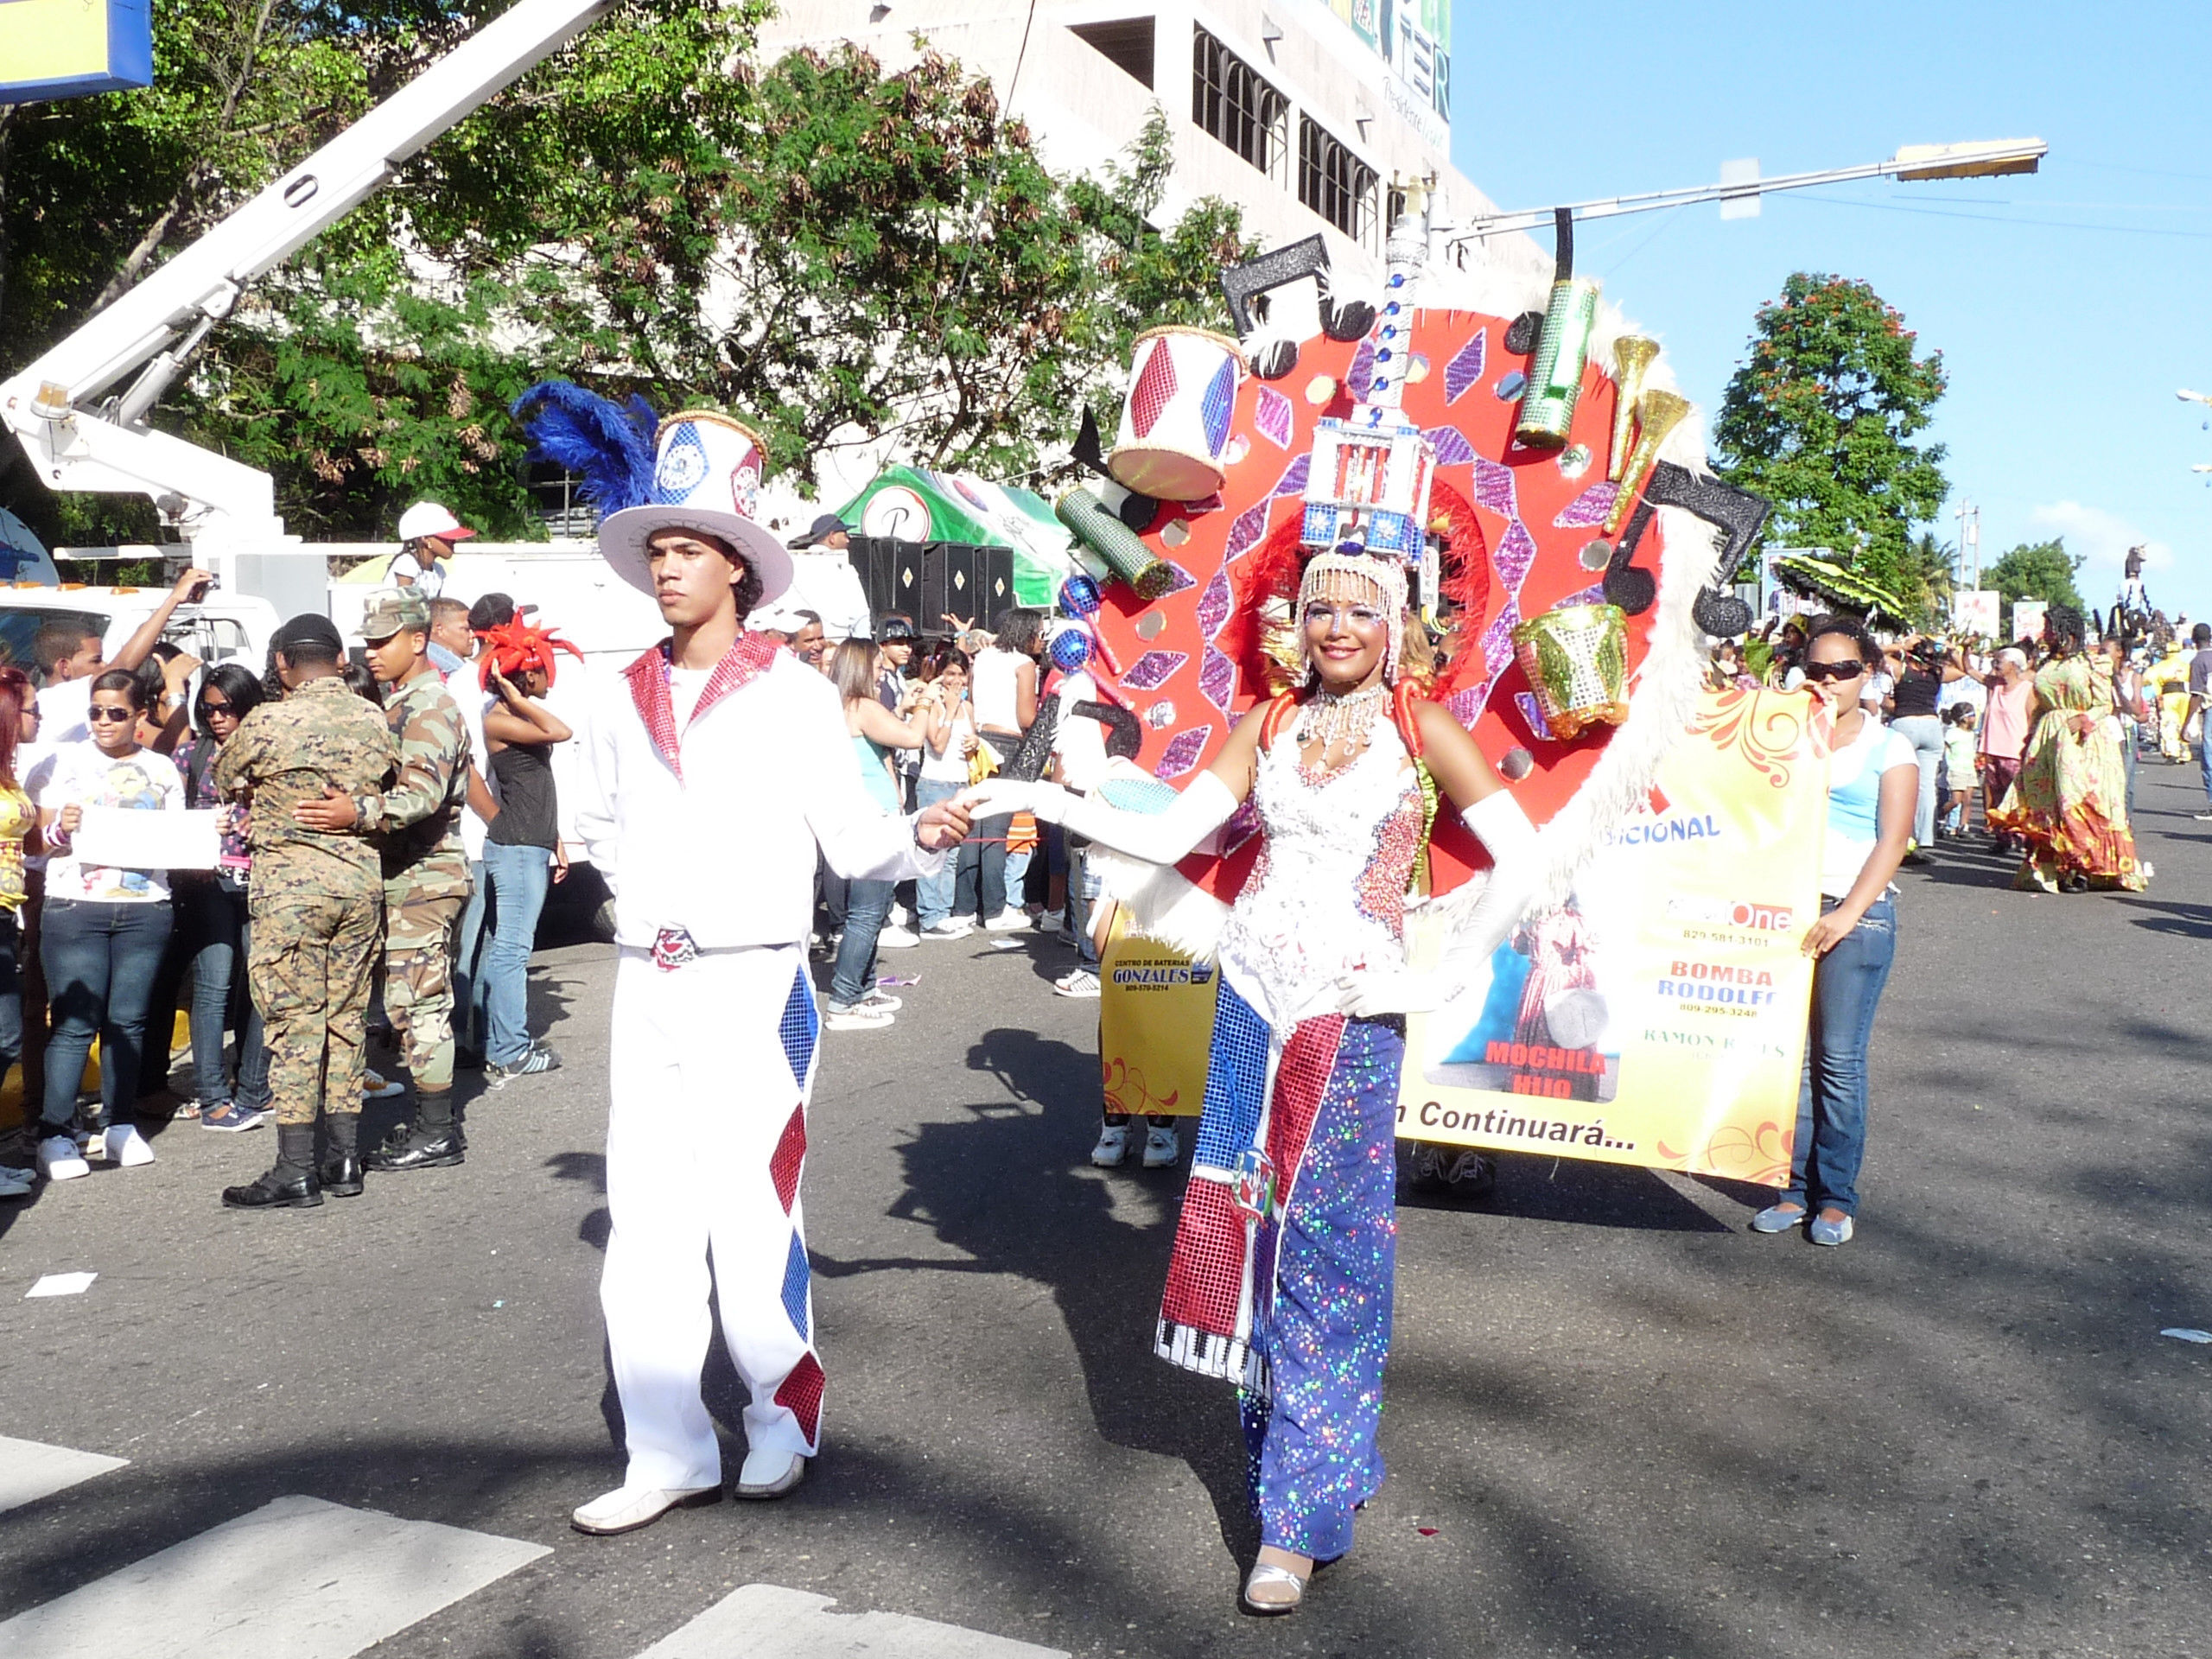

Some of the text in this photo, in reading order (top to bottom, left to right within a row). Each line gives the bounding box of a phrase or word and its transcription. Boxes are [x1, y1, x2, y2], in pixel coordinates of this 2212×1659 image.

[1729, 901, 1792, 933] One
[1113, 968, 1190, 984] GONZALES
[1670, 960, 1773, 987] BOMBA
[1643, 1028, 1715, 1046] RAMON
[1484, 1040, 1606, 1075] MOCHILA
[1420, 1101, 1635, 1151] Continuará...
